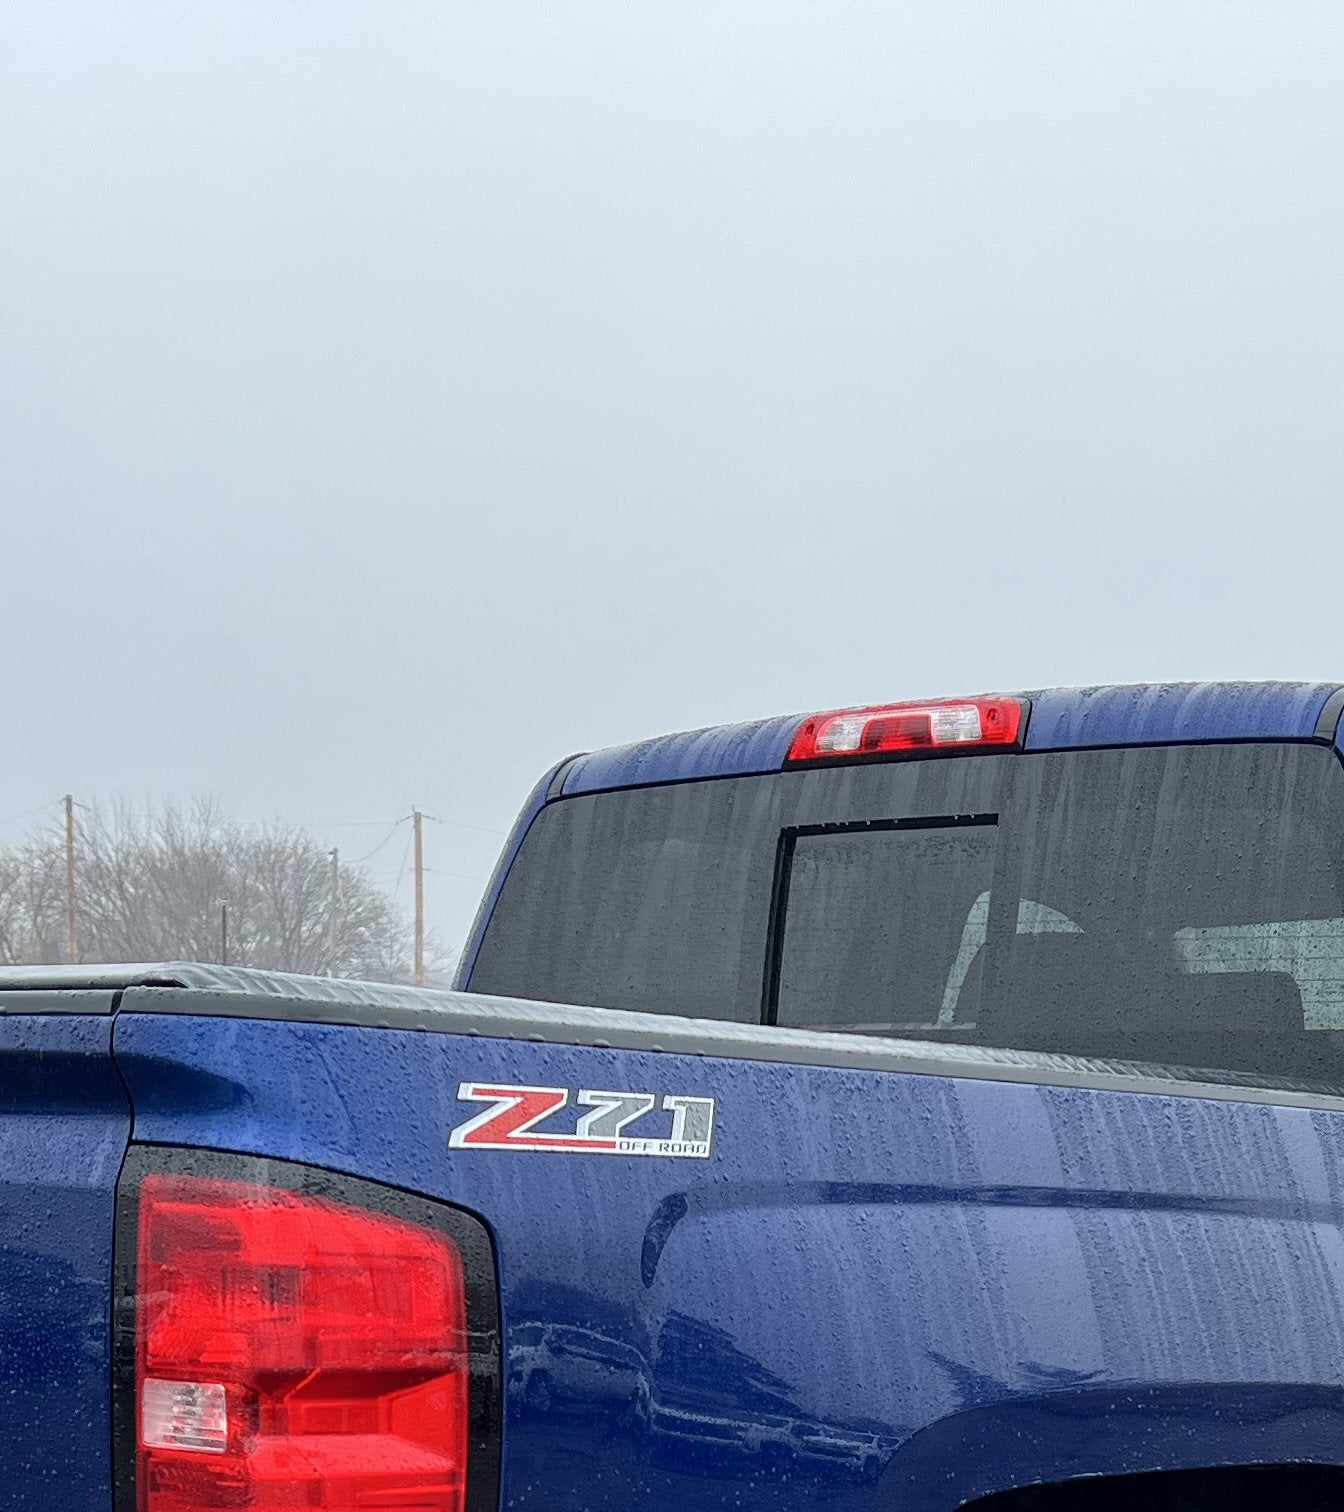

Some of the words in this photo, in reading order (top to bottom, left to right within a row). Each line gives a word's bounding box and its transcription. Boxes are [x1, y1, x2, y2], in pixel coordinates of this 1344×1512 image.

[448, 1082, 714, 1158] Z71
[619, 1141, 654, 1152] OFF
[659, 1142, 706, 1154] ROAD
